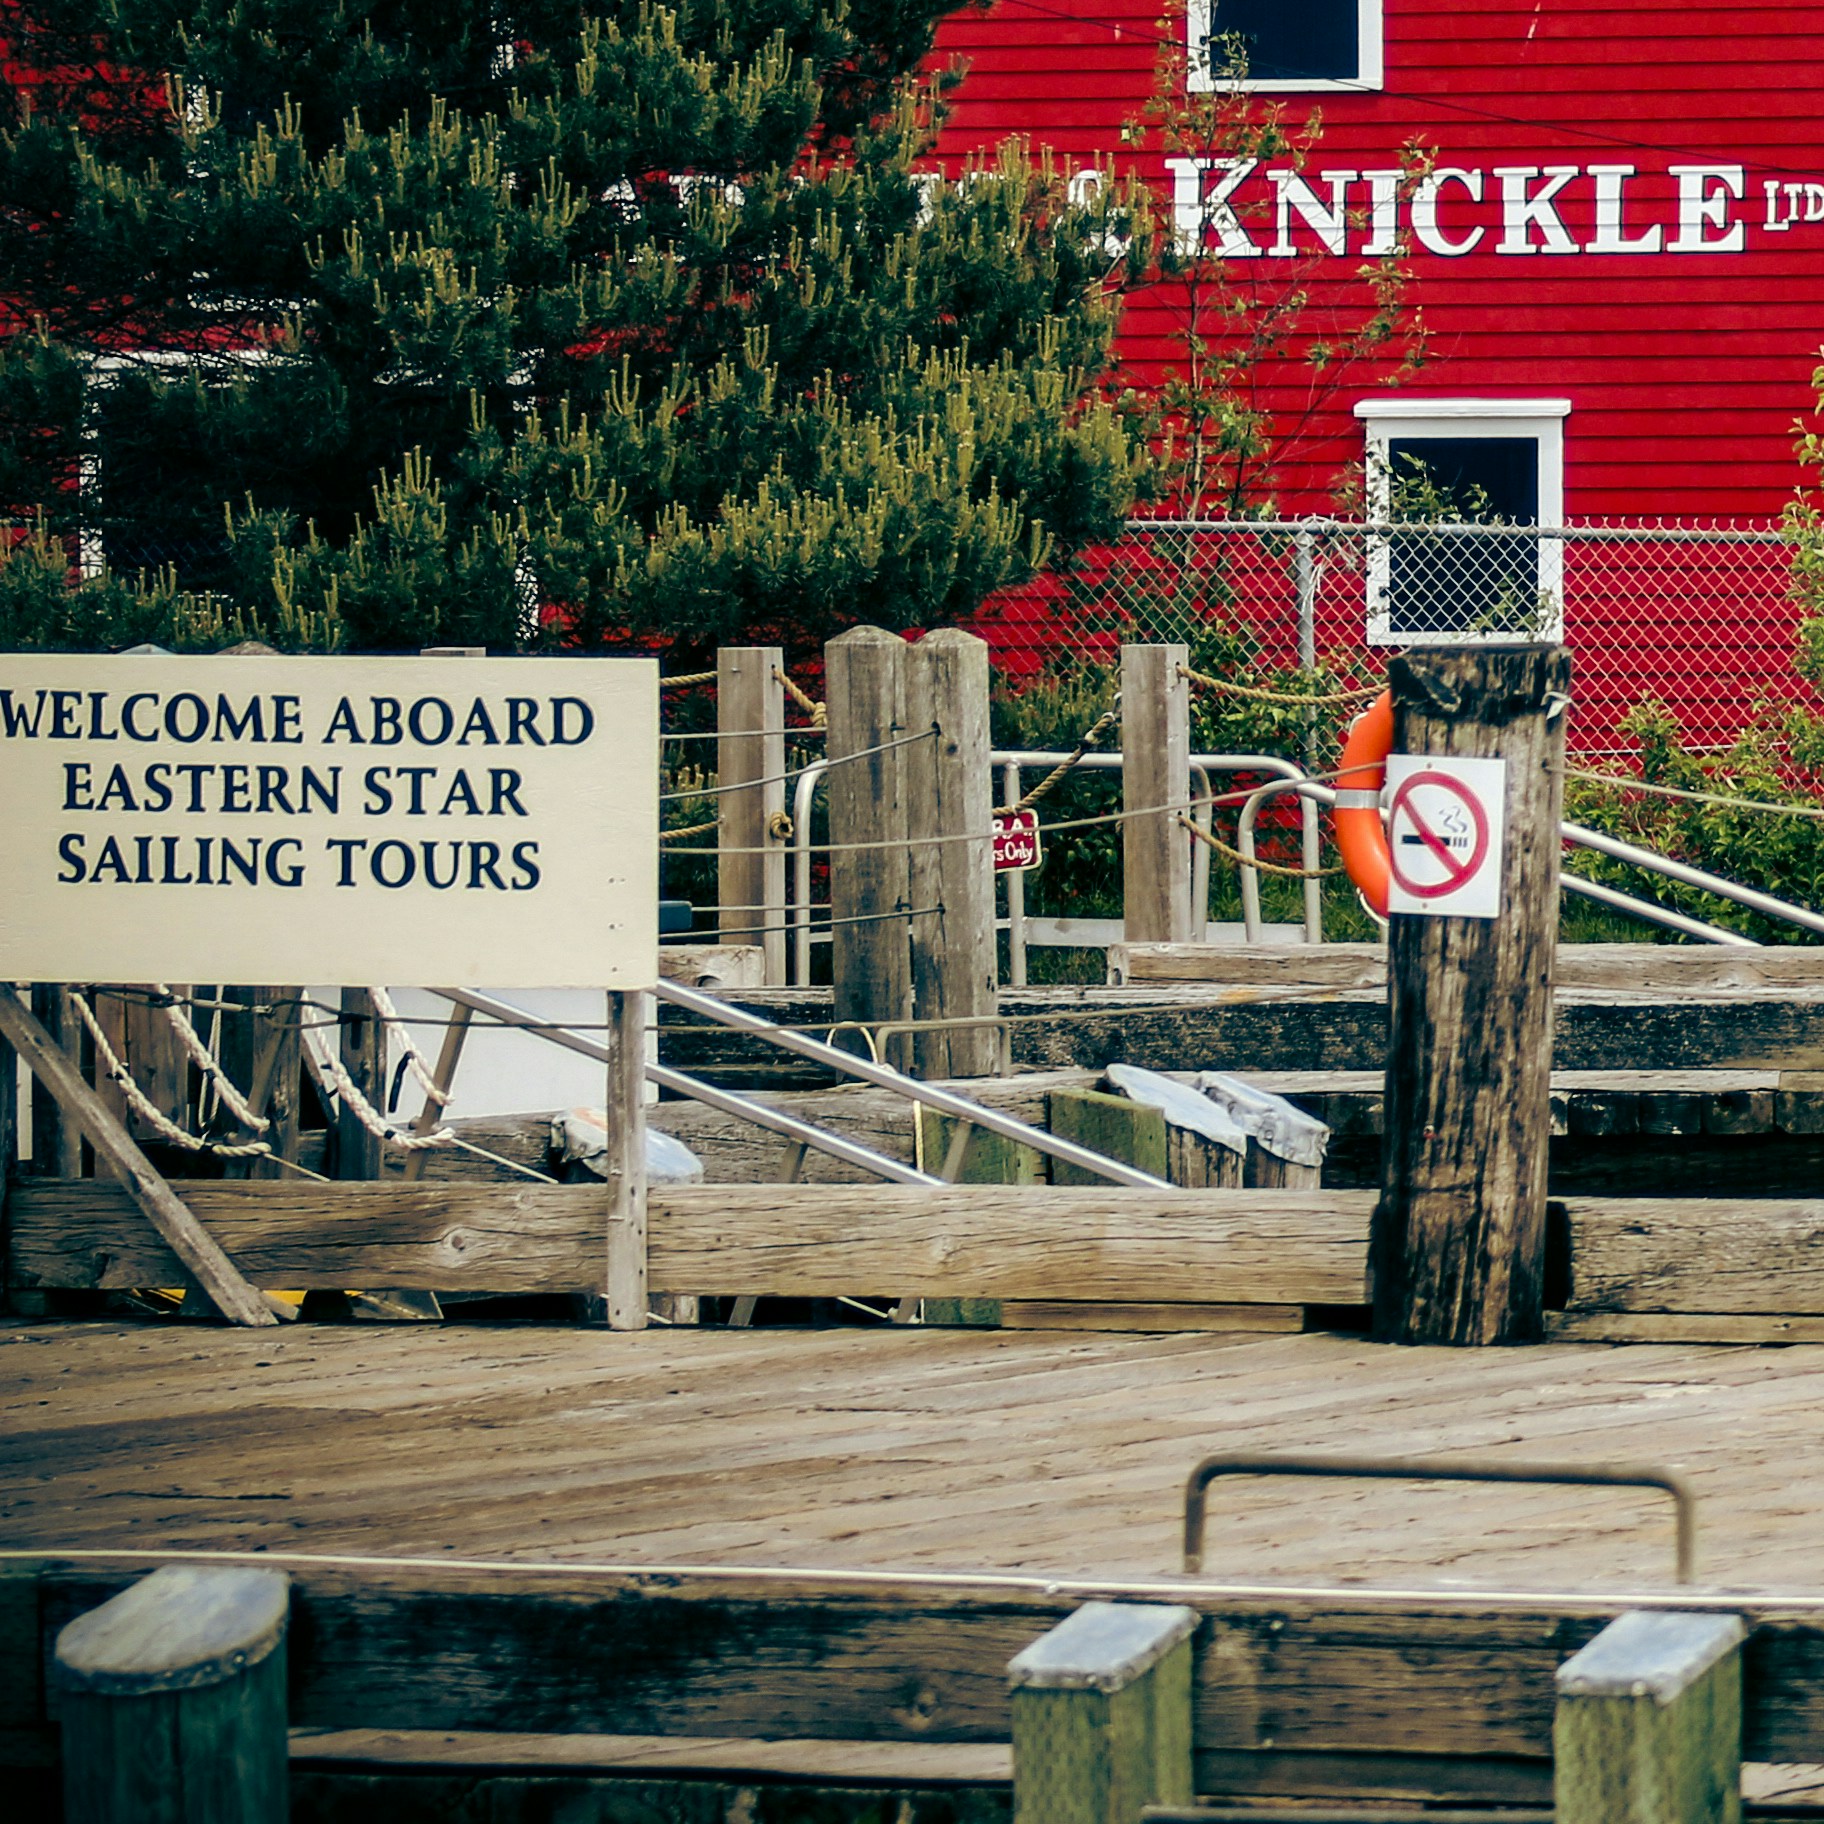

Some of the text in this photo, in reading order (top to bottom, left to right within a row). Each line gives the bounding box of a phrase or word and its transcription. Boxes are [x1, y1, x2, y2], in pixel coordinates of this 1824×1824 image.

[1164, 156, 1744, 258] KNICKLE
[0, 689, 594, 747] WELCOME ABOARD
[62, 762, 529, 817] EASTERN STAR
[57, 833, 541, 891] SAILING TOURS
[1004, 841, 1034, 866] Only
